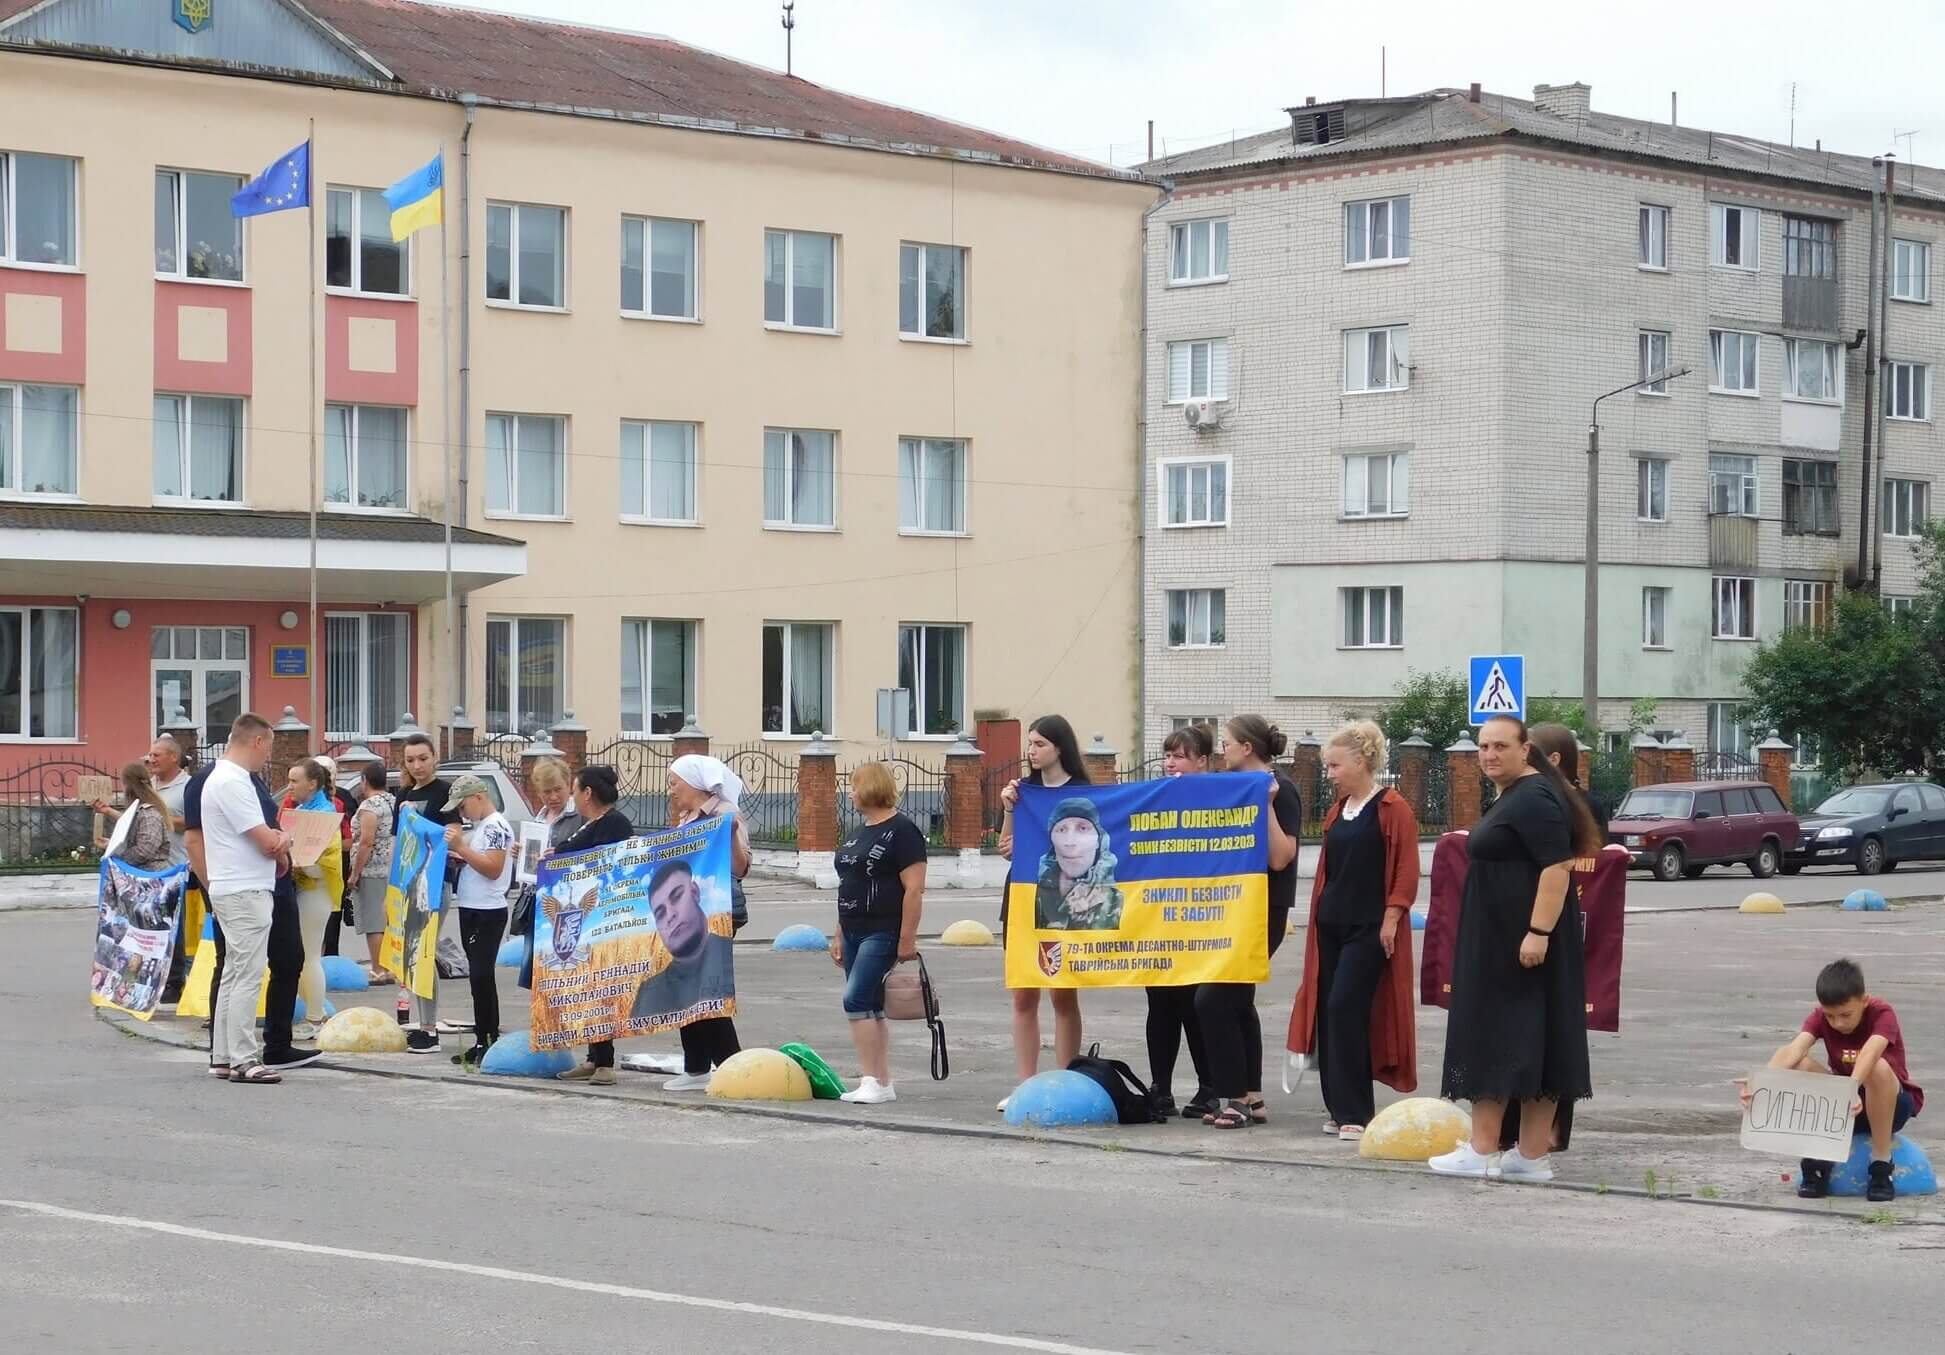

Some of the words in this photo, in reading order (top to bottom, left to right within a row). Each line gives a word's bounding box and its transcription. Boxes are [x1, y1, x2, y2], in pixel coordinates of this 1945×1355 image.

[1129, 809, 1178, 832] ЛОБАН
[1181, 805, 1259, 829] ОЛЕКСАНДР
[578, 847, 617, 866] БЕЗВІСТИ
[625, 839, 638, 851] НЕ
[1129, 841, 1158, 855] ЗНИК
[1159, 838, 1208, 854] БЕЗВІСТИ
[1209, 833, 1256, 852] 12.03.2023
[562, 863, 614, 883] ПОВЕРНІТЬ
[618, 852, 654, 869] ТІЛЬКИ
[1143, 887, 1188, 904] ЗНИКЛІ
[1191, 884, 1242, 903] БЕЗВІСТИ
[1163, 907, 1178, 922] НЕ
[604, 917, 648, 934] БАТАЛЬЙОН
[1066, 942, 1095, 955] 79-ТА
[1096, 939, 1134, 954] ОКРЕМА
[1136, 937, 1232, 955] ДЕСАНТНО-ШТУРМОВА
[592, 961, 649, 982] ГЕННАДІЙ
[1069, 956, 1129, 973] ТАВРІЙСЬКА
[1131, 956, 1173, 972] БРИГАДА
[548, 983, 632, 1007] МИКОЛАЙОВИЧ
[582, 1023, 616, 1040] ДУШУ
[626, 1010, 686, 1030] ЗМУСИЛИ
